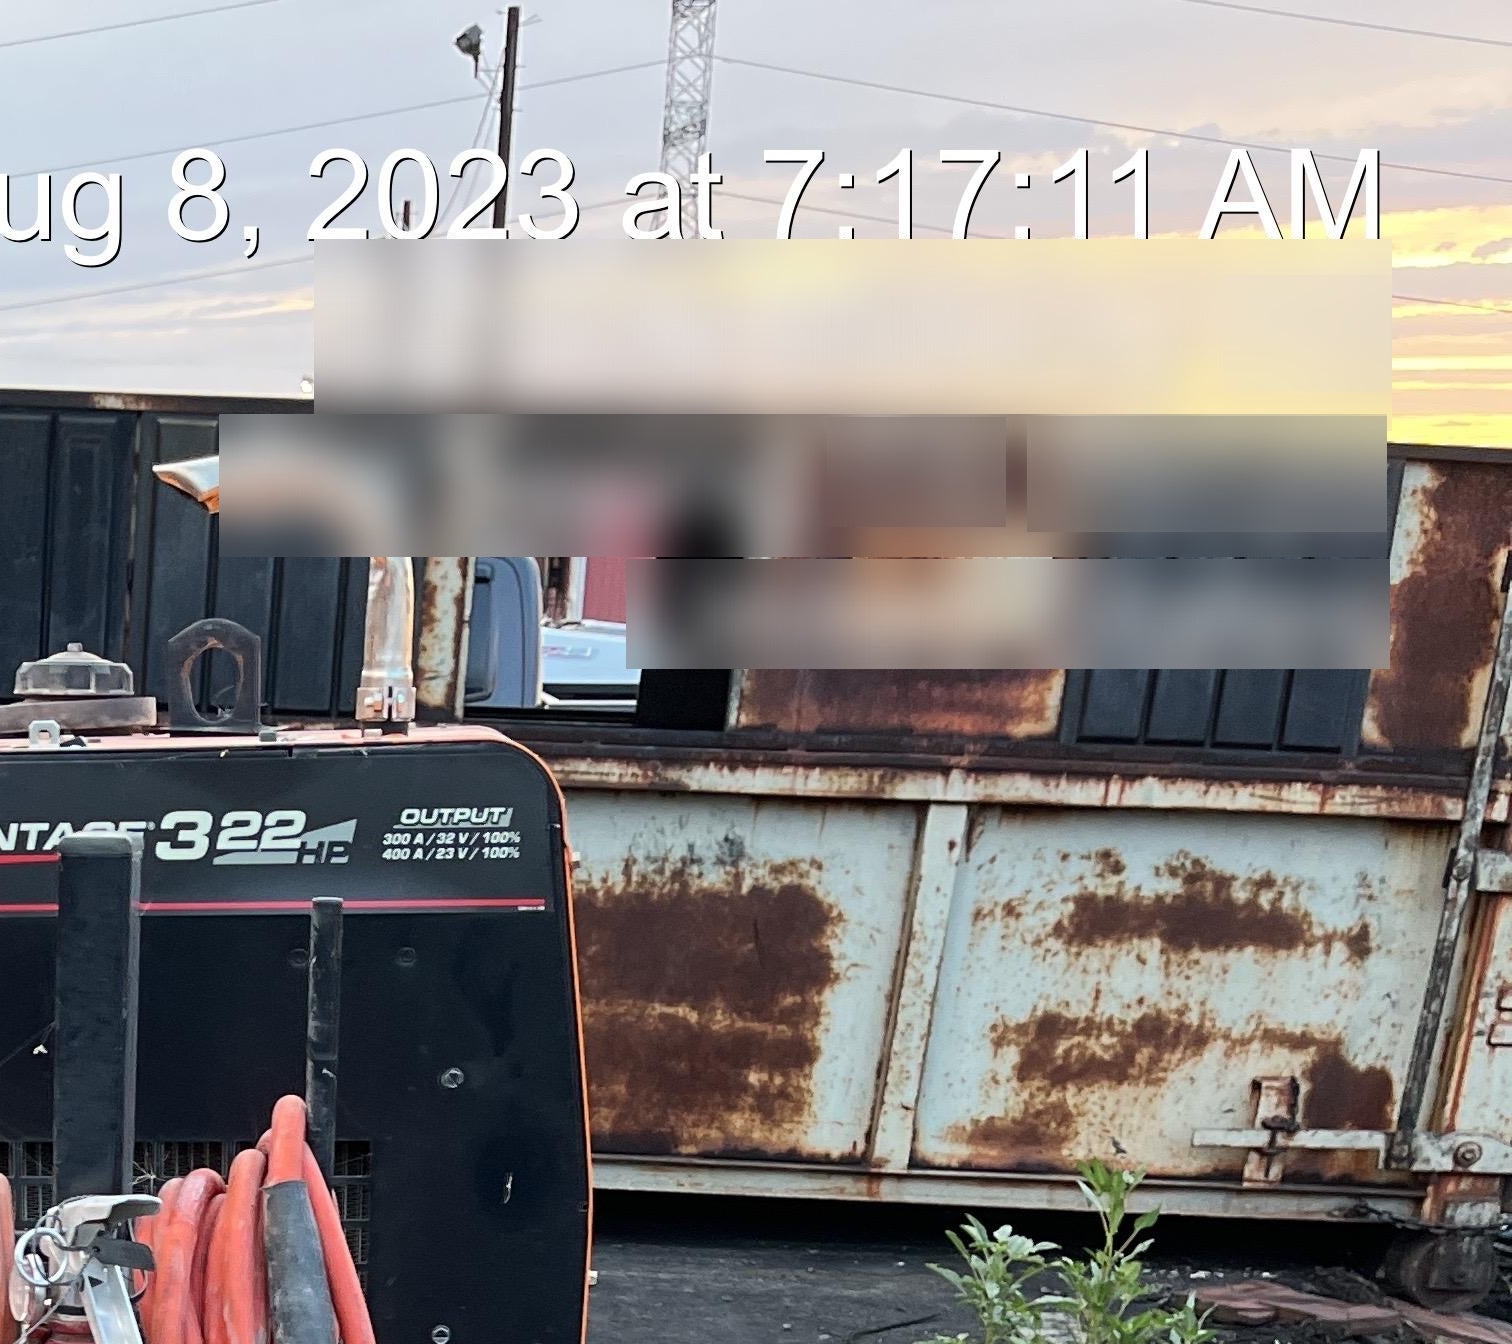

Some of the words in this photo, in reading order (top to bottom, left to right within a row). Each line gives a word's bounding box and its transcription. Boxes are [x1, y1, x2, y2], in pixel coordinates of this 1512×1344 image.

[400, 807, 506, 825] OUTPUT
[155, 809, 307, 862] 322
[382, 832, 411, 846] 300
[436, 832, 456, 846] 32
[483, 831, 521, 845] 100%
[382, 847, 411, 861] 400
[435, 847, 455, 861] 23
[482, 846, 521, 860] 100%
